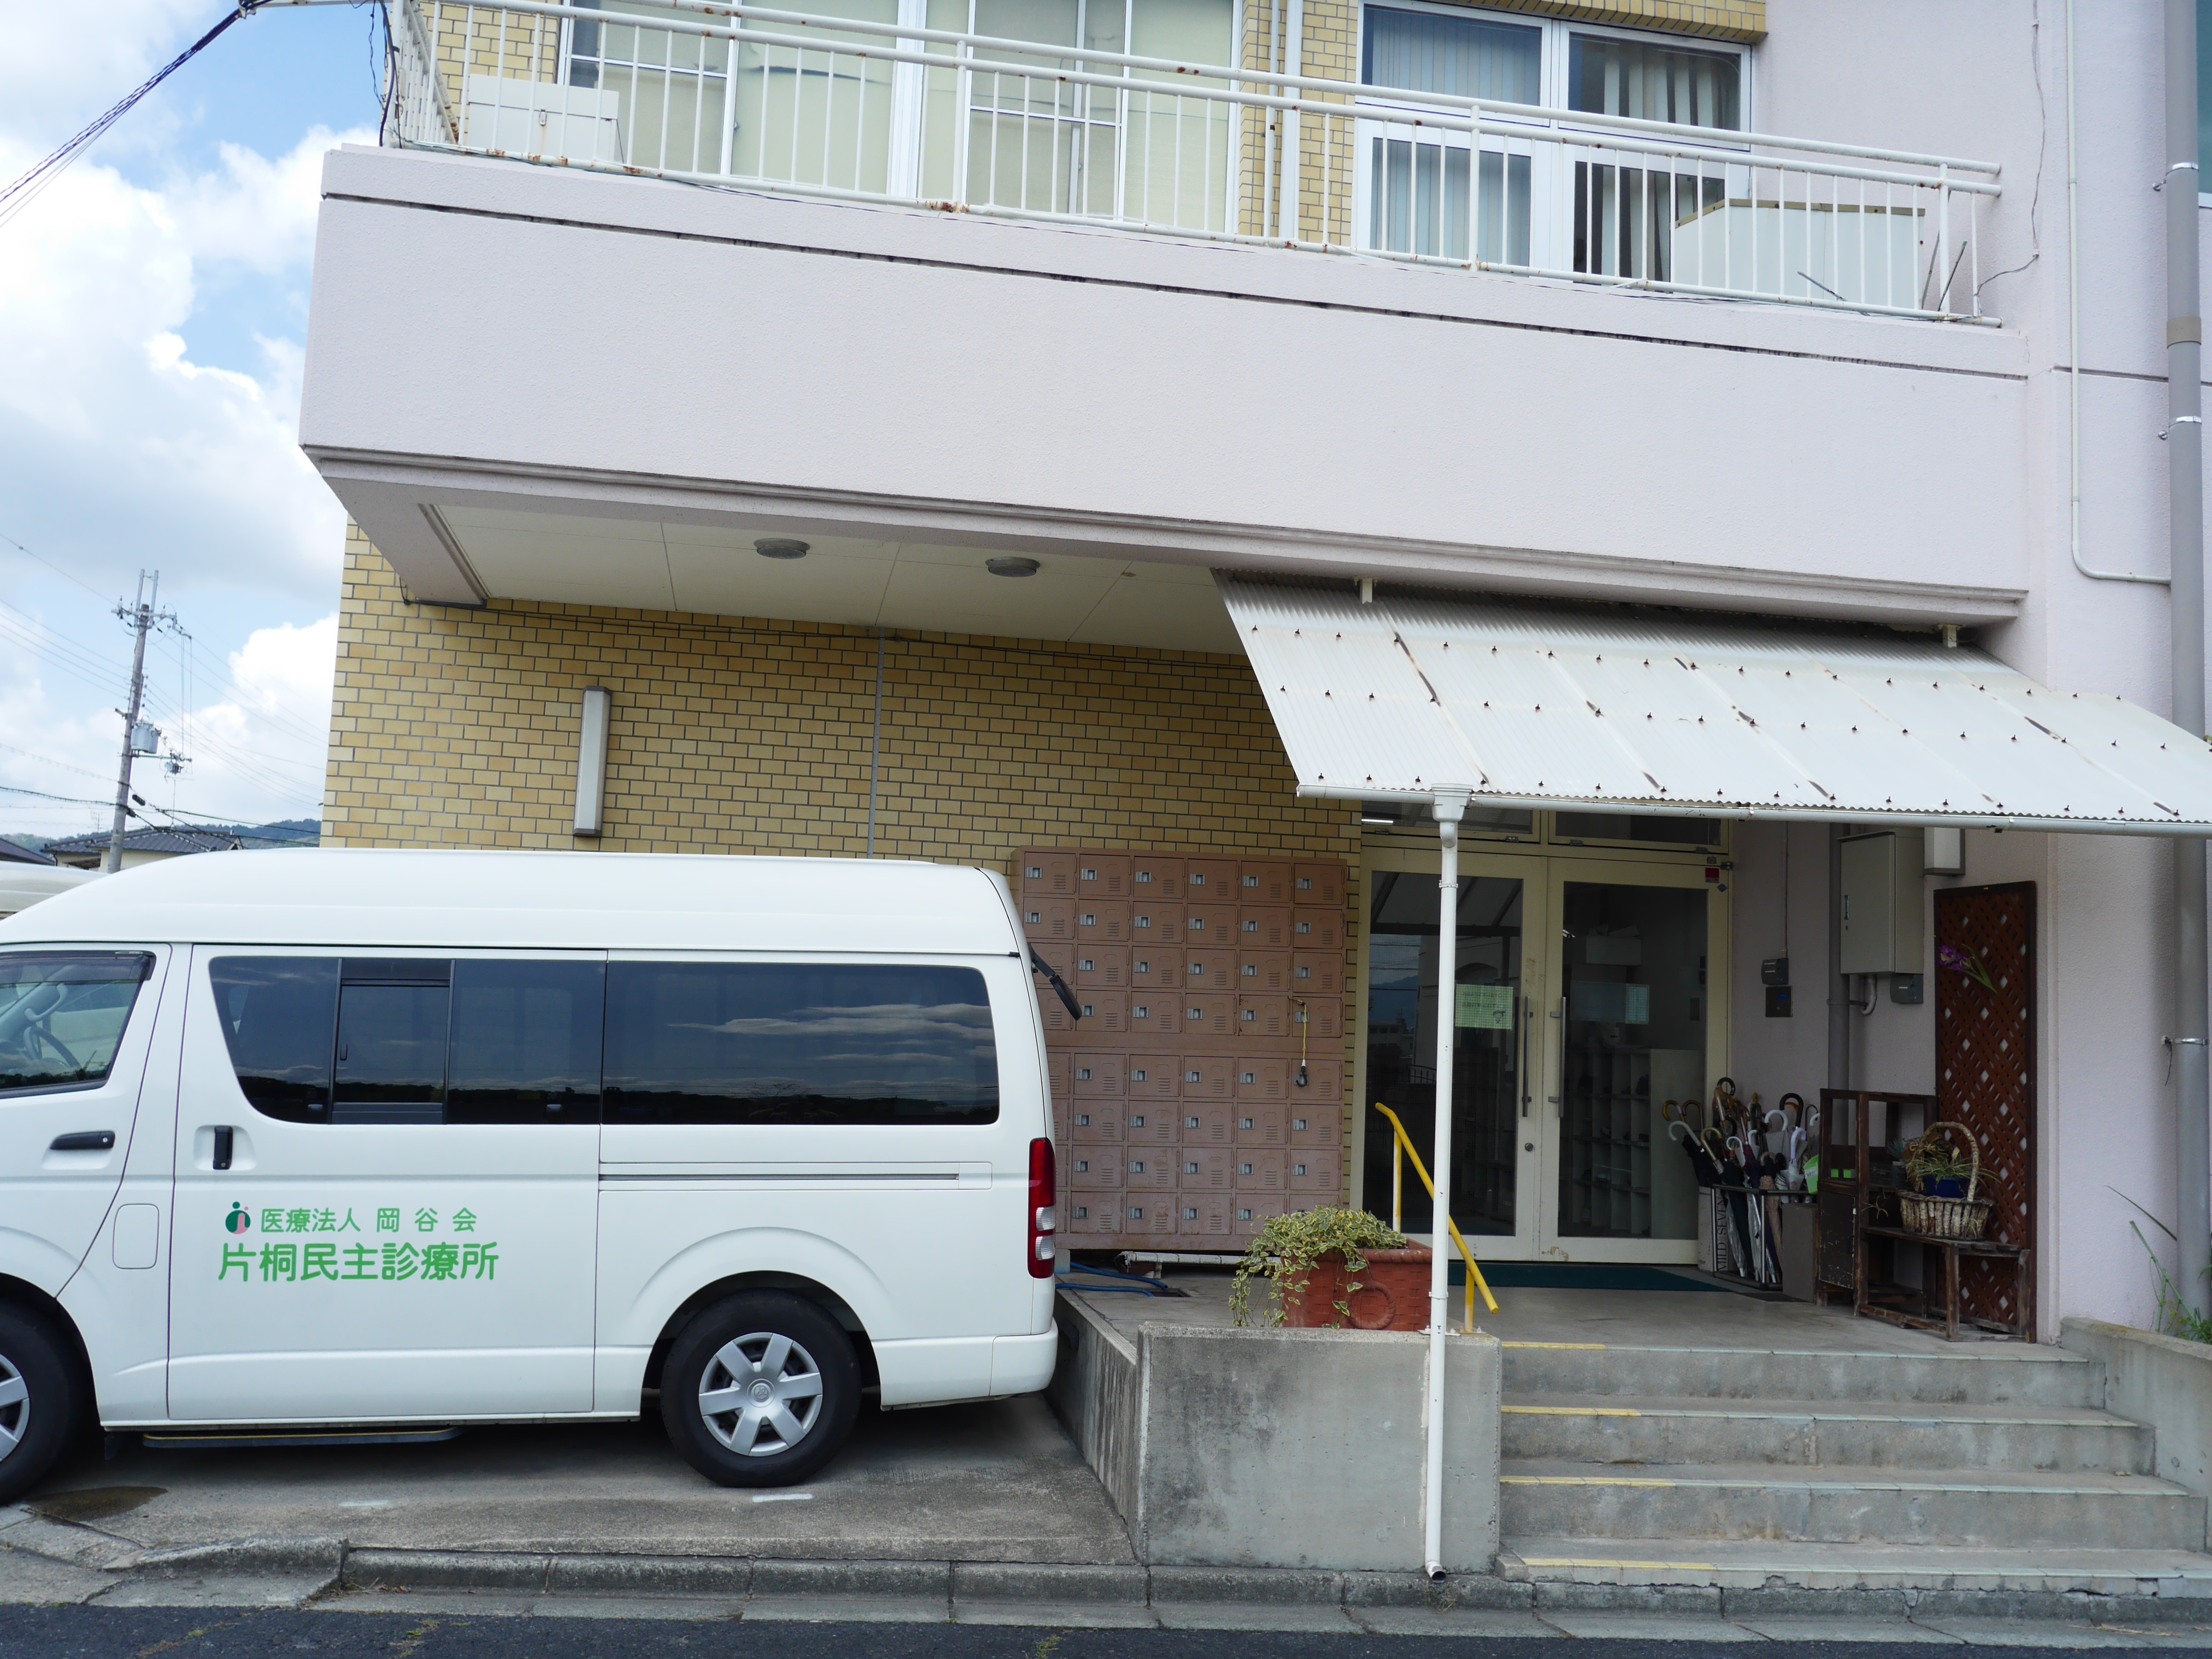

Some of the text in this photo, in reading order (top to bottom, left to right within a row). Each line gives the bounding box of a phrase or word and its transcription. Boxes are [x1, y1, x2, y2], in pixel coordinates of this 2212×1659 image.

[261, 1207, 477, 1232] 医療法人 岡谷会
[1717, 1196, 1727, 1271] MILD SEVEN
[218, 1242, 499, 1282] 片桐民主診療所
